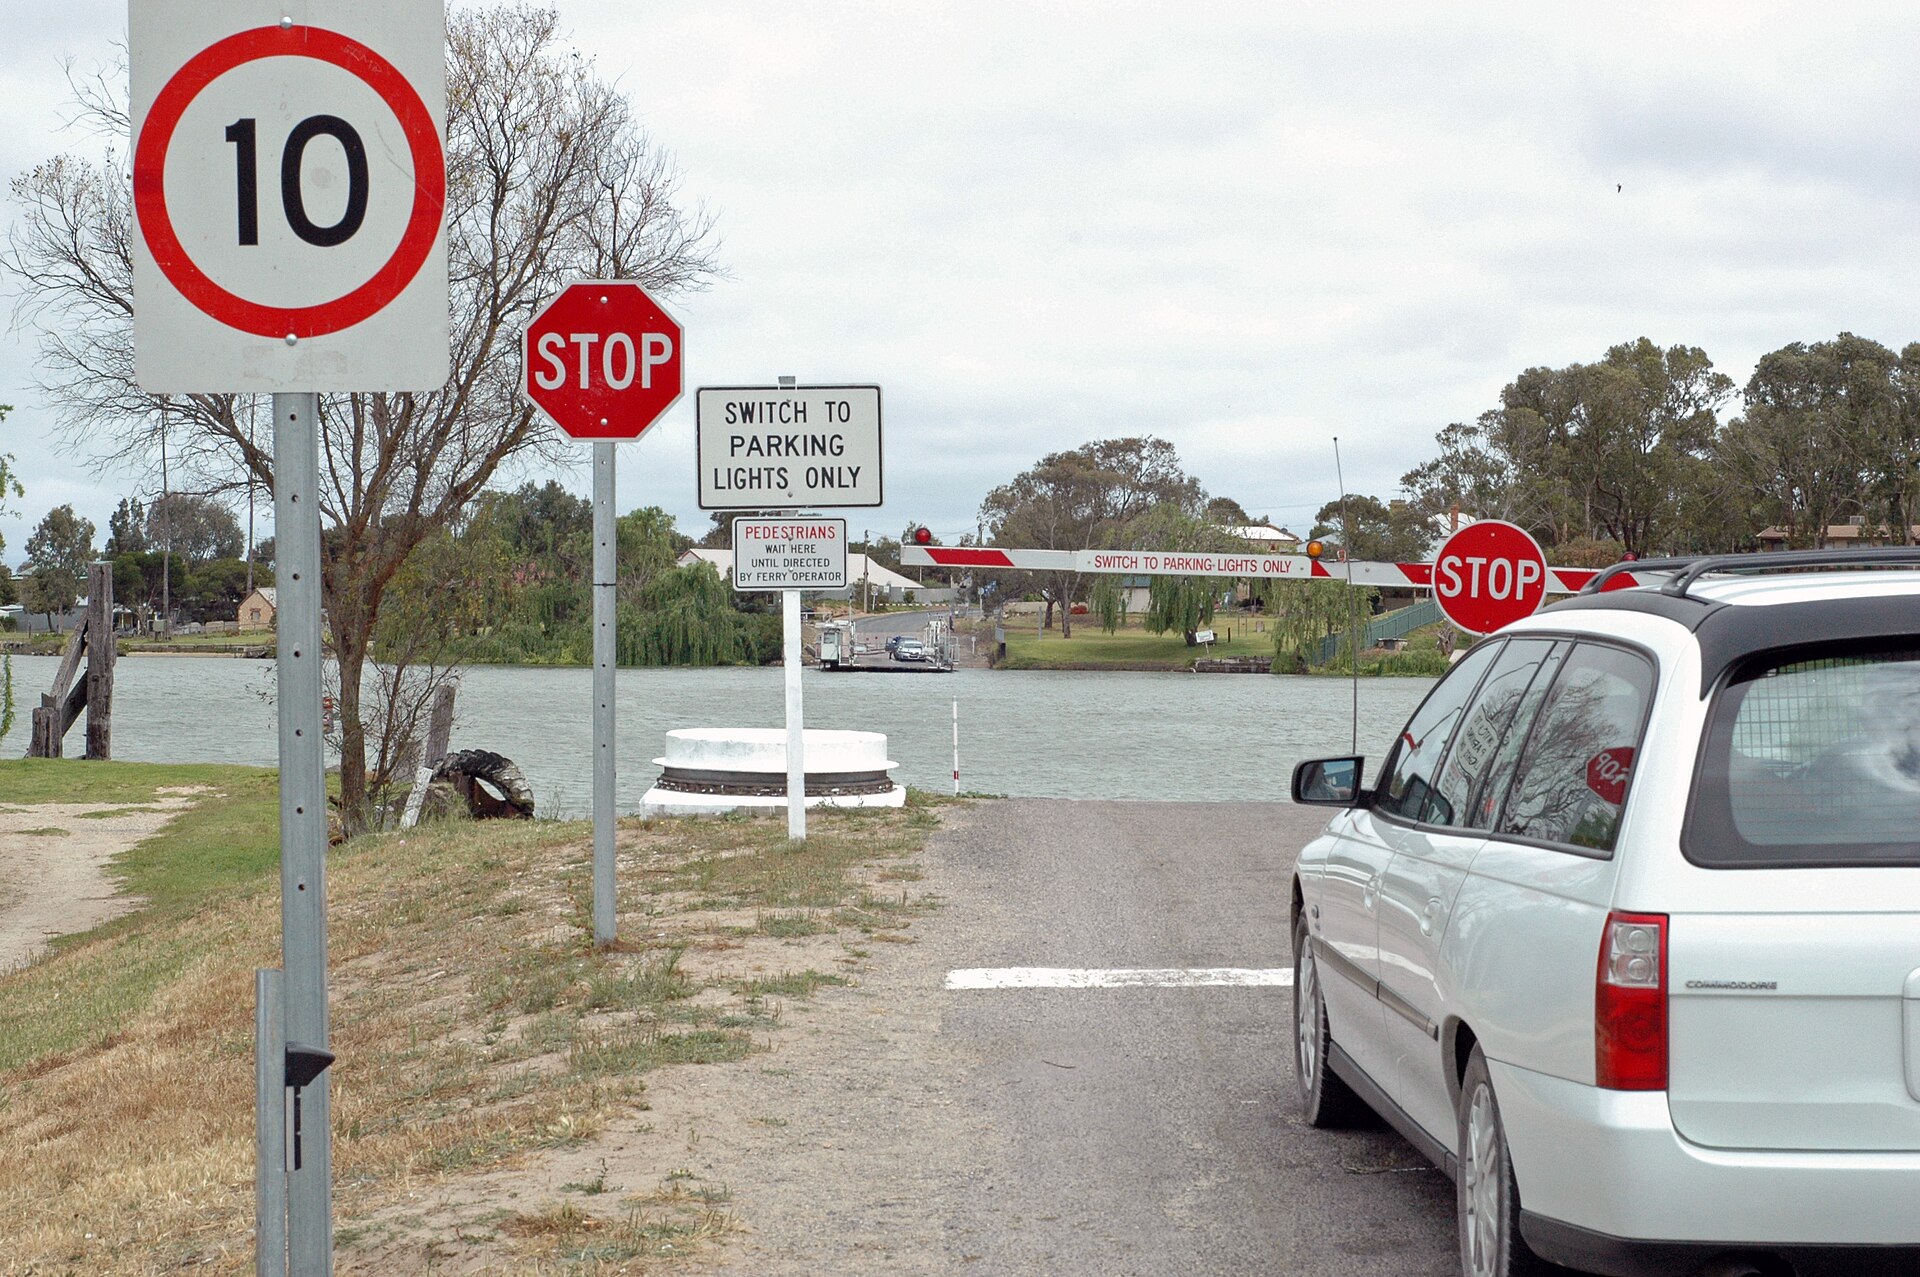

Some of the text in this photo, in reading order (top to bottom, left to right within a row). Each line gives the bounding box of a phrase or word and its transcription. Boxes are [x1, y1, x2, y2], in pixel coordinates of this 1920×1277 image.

[225, 114, 369, 247] 10
[534, 332, 673, 390] STOP
[725, 401, 850, 424] SWITCH TO
[730, 434, 844, 457] PARKING
[714, 466, 861, 490] LIGHTS ONLY
[745, 526, 836, 539] PEDESTRIANS
[765, 544, 816, 554] WAIT HERE
[751, 558, 830, 568] UNTIL DIRECTED
[1094, 555, 1292, 574] SWITCH TO PARKING LIGHTS ONLY
[740, 571, 842, 582] BY FERRY OPERATOR
[1438, 555, 1540, 601] STOP
[1685, 981, 1777, 990] COMMODORE
